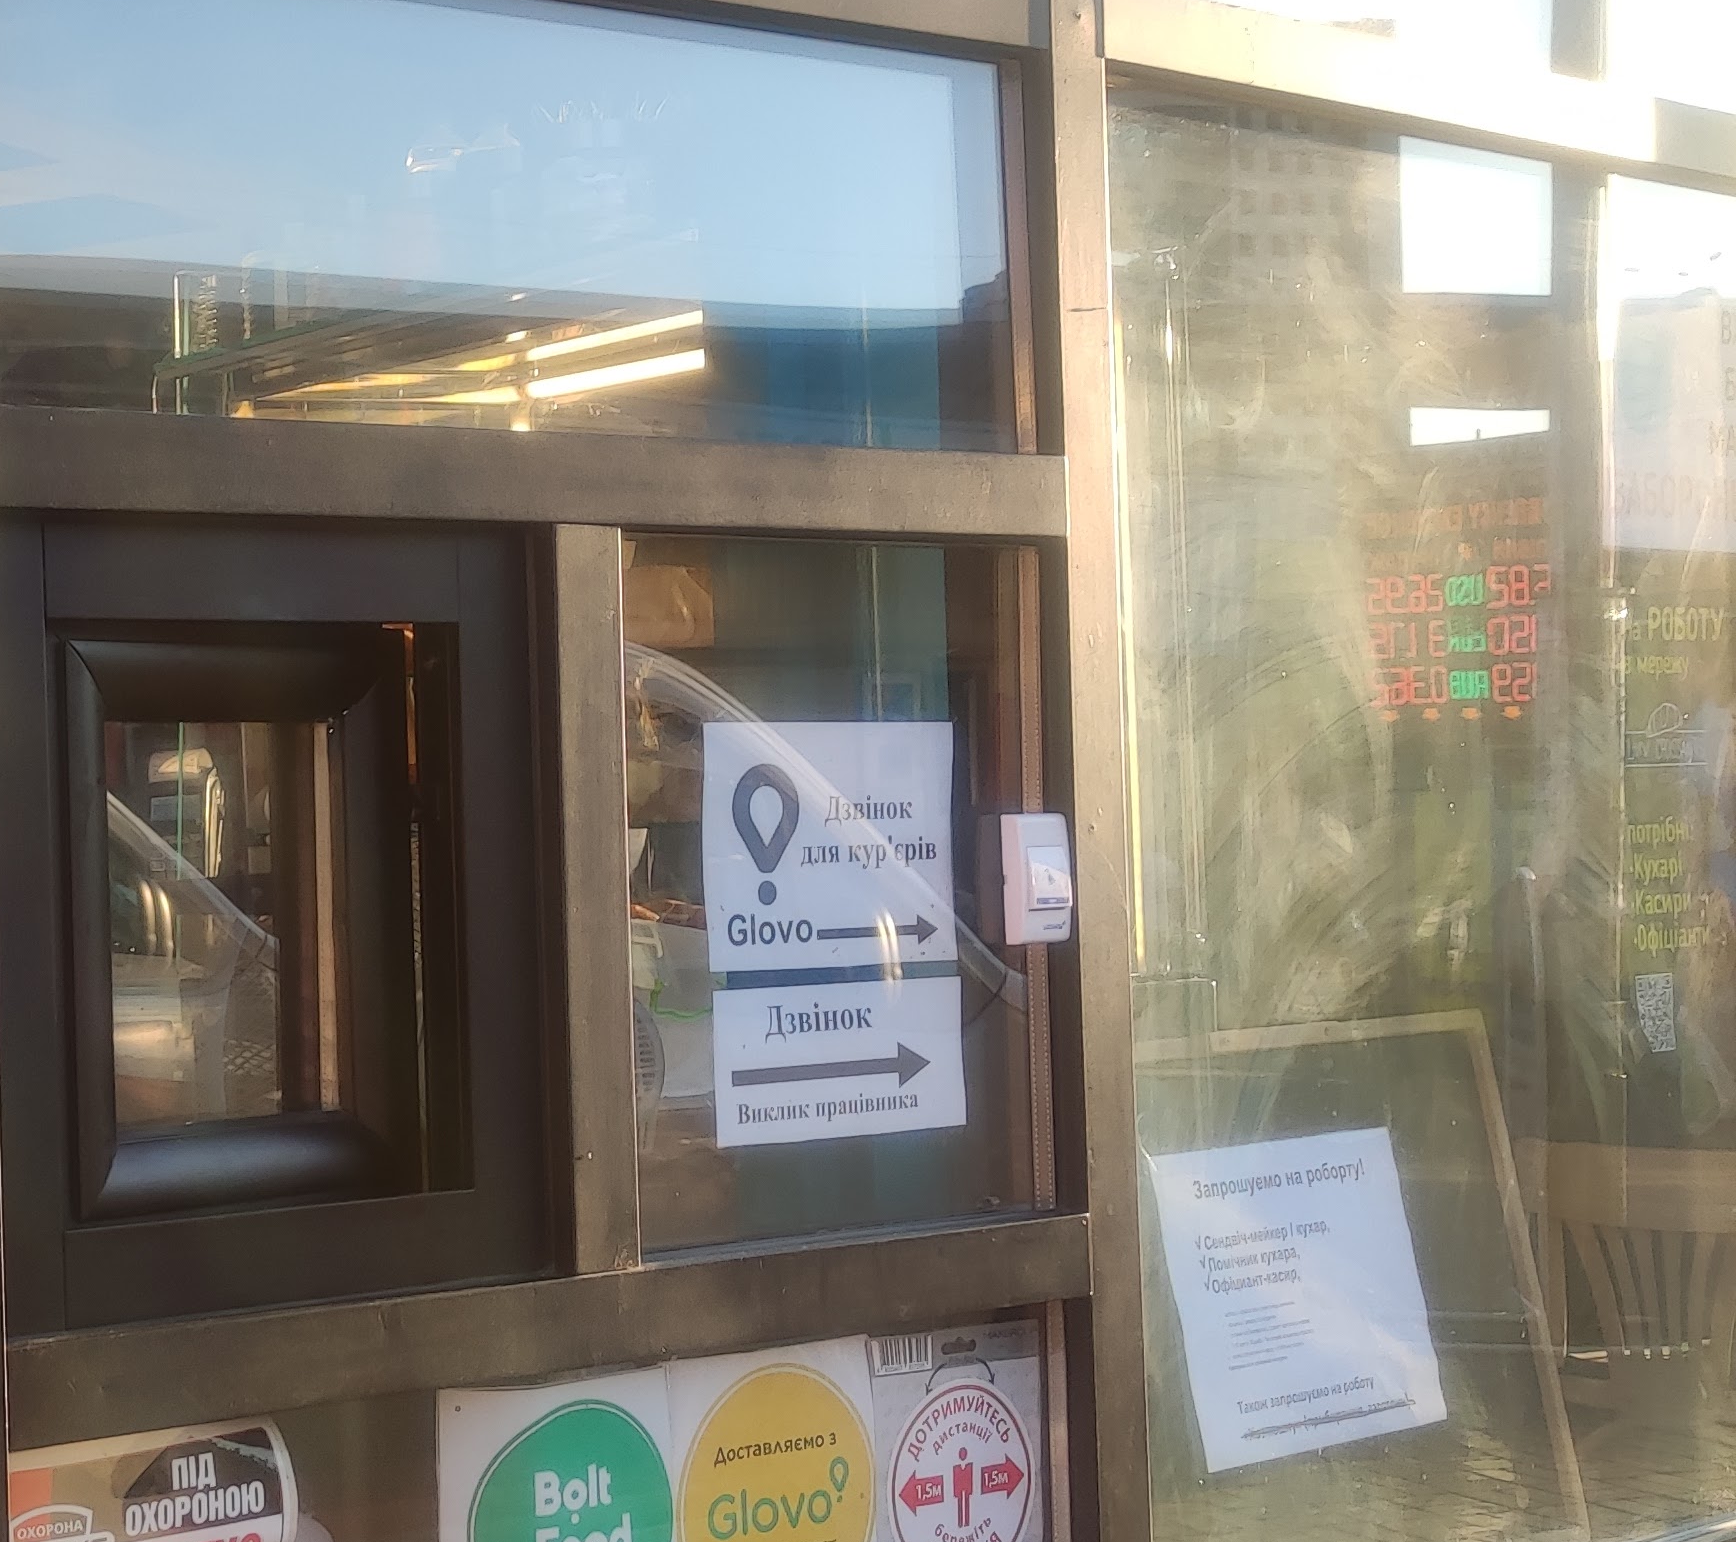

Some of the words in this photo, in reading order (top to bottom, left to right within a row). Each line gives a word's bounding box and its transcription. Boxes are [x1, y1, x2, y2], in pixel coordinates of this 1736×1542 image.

[1648, 607, 1725, 641] РОБОТУ
[824, 795, 913, 827] Дзвінок
[801, 844, 841, 867] для
[848, 835, 937, 870] кур'єрів
[727, 913, 813, 946] Glovo
[765, 1002, 873, 1044] Дзвінок
[736, 1102, 810, 1125] Виклик
[815, 1093, 919, 1122] працівника
[1285, 1171, 1304, 1187] на
[907, 1395, 1011, 1462] ДОТРИМУЙТЕСЬ
[932, 1421, 993, 1455] дистанції
[714, 1432, 825, 1468] Доставляємо
[828, 1432, 838, 1446] з
[171, 1451, 217, 1491] ПІД
[915, 1481, 942, 1500] 1,5м
[983, 1470, 1009, 1486] 1,5м
[534, 1463, 613, 1518] Bolt
[125, 1480, 266, 1537] ОХОРОНОЮ
[707, 1488, 833, 1541] Glovo
[16, 1518, 84, 1541] ОХОРОНА
